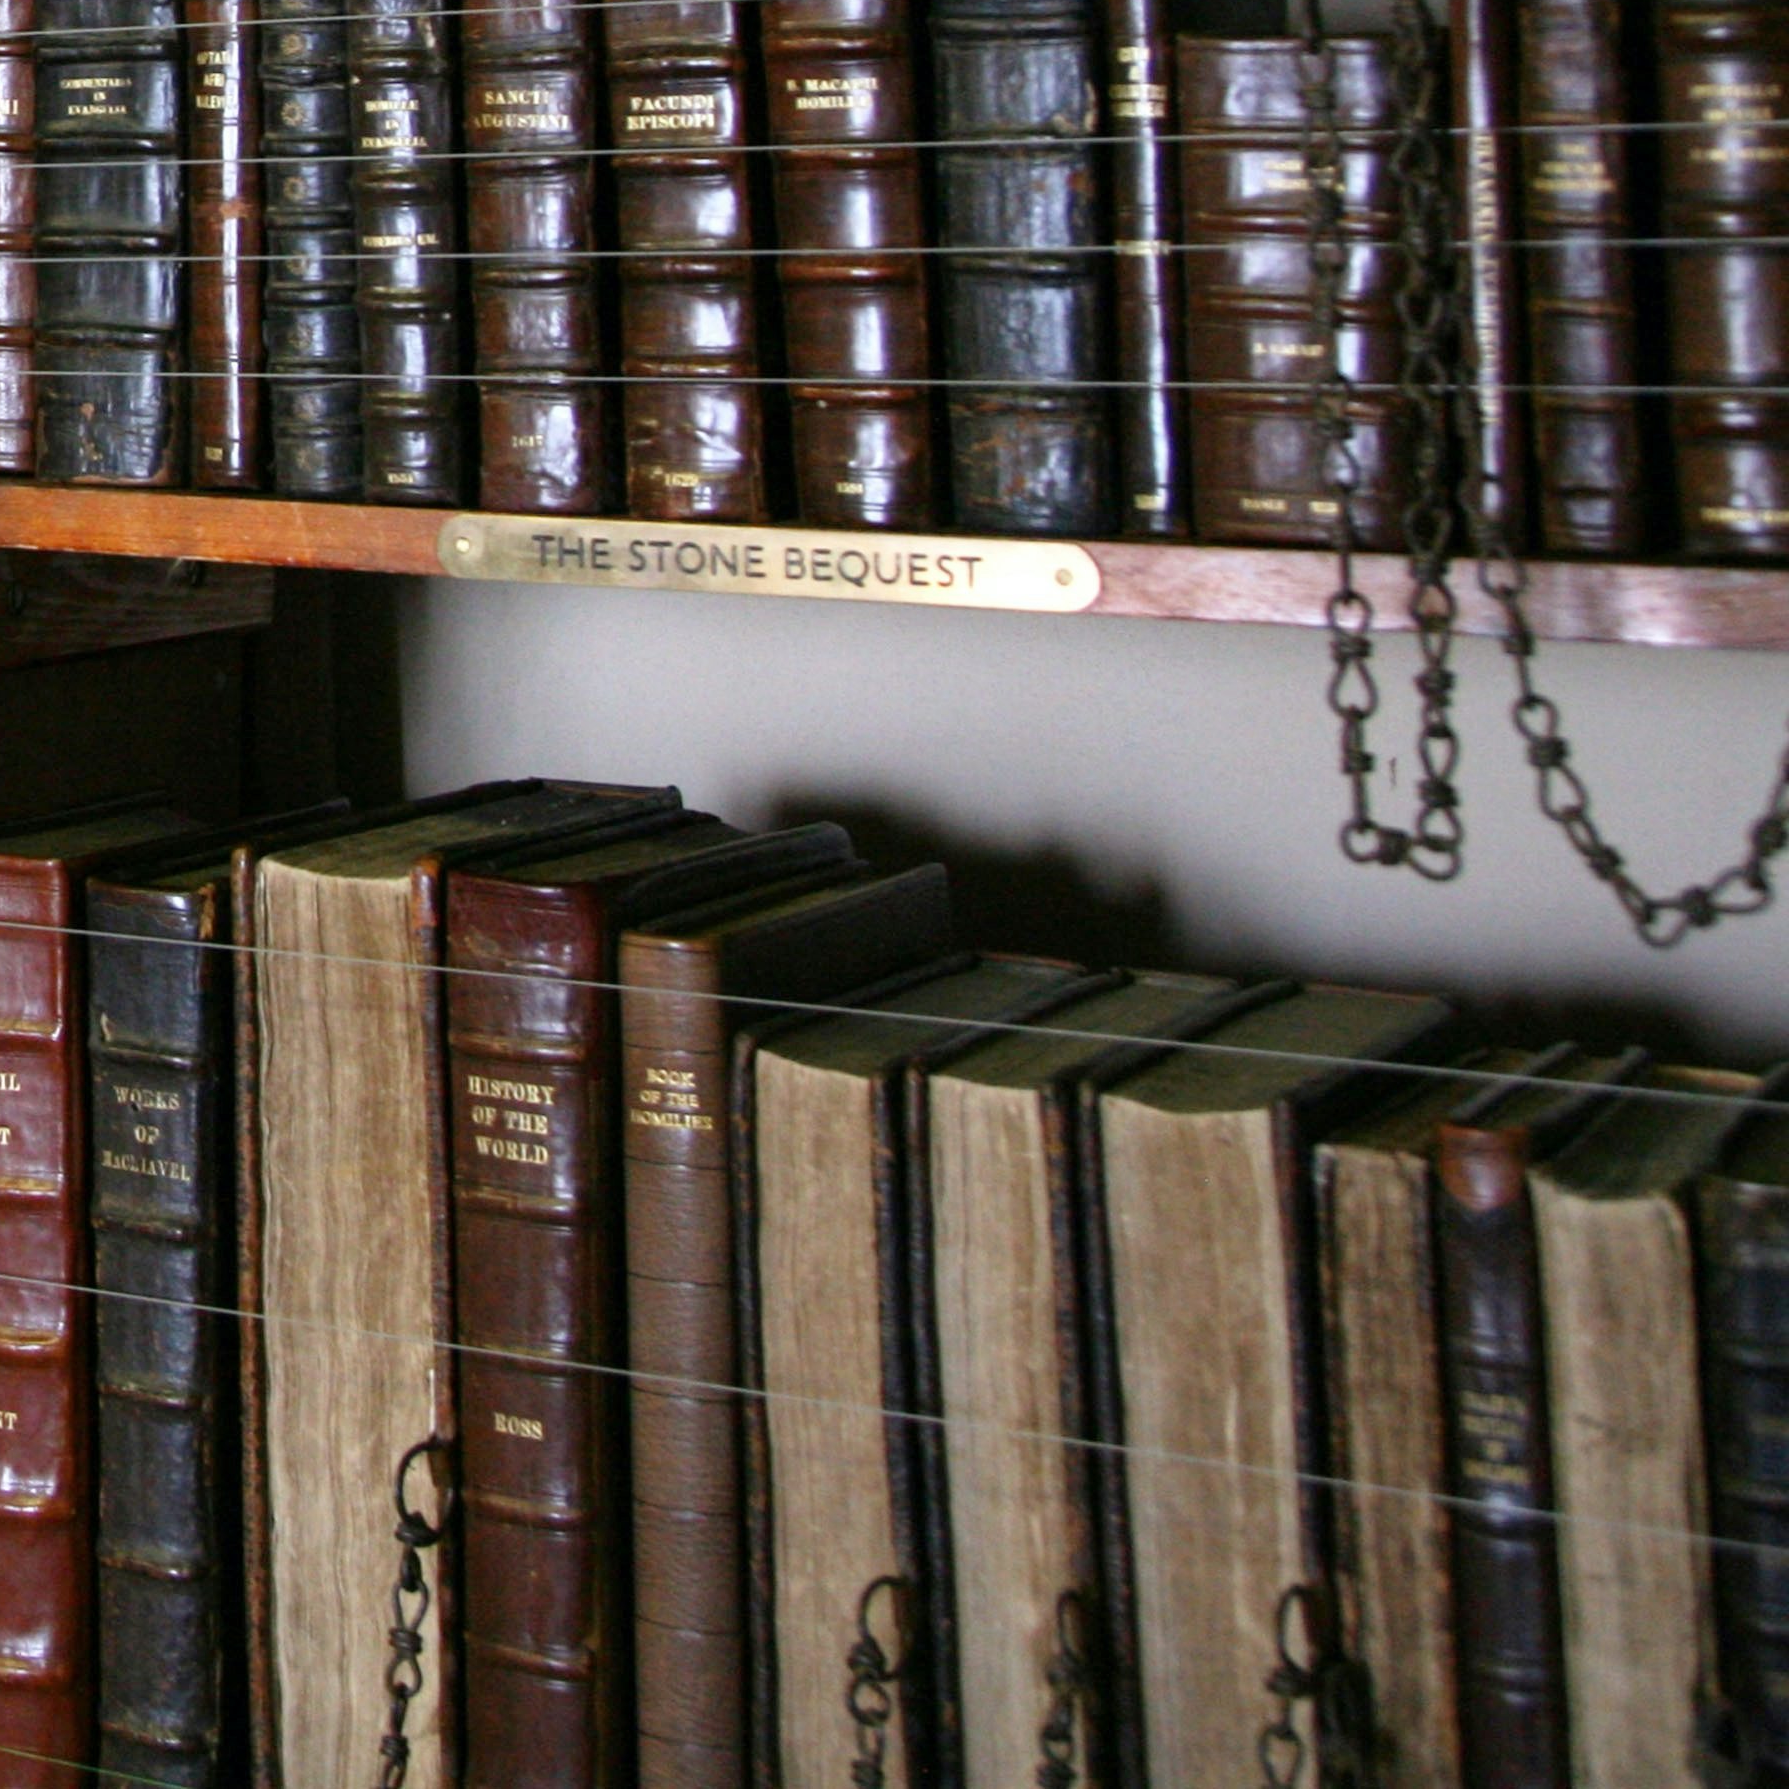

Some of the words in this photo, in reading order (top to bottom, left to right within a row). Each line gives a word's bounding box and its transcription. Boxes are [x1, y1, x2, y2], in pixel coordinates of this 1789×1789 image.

[630, 94, 716, 111] FACUNDI
[474, 114, 570, 131] AUGUSTINI
[626, 113, 716, 131] EPISCOPI
[532, 535, 615, 571] THE
[627, 540, 766, 579] STONE
[785, 547, 983, 588] BEQUEST
[646, 1067, 696, 1089] BOOK
[113, 1084, 182, 1112] WORKS
[467, 1074, 555, 1106] HISTORY
[639, 1088, 661, 1107] OF
[668, 1090, 699, 1109] THE
[472, 1108, 498, 1127] OF
[505, 1110, 549, 1136] THE
[629, 1110, 714, 1132] HOMILIES
[134, 1125, 159, 1146] OF
[476, 1135, 550, 1165] WORLD
[493, 1413, 545, 1441] ROSS
